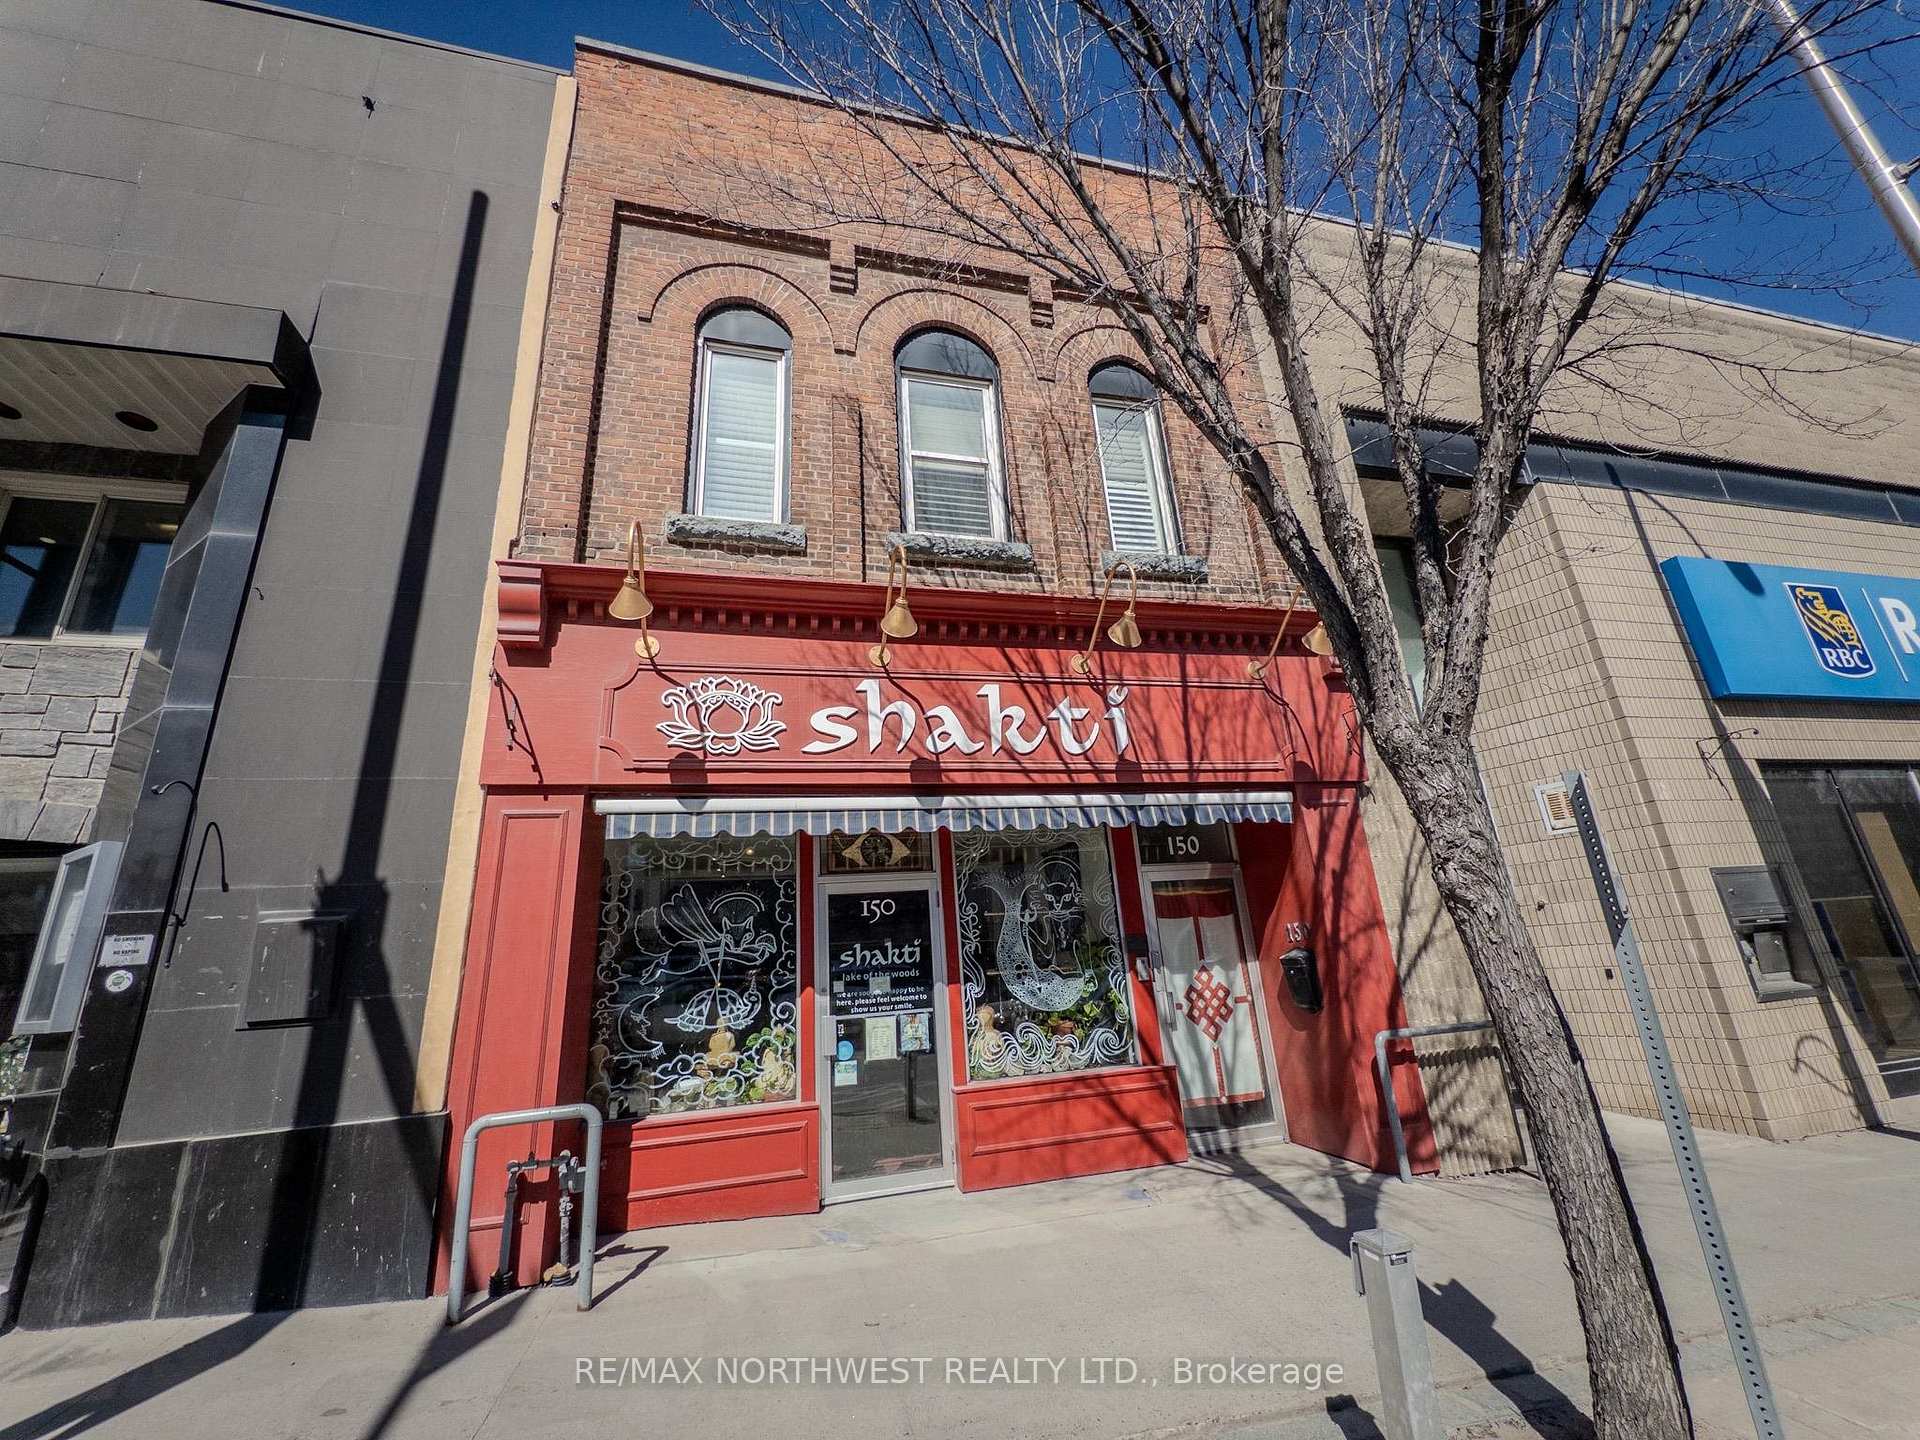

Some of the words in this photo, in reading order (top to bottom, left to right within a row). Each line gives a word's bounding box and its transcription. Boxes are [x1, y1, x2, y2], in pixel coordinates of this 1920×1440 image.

[1821, 647, 1869, 668] RBC
[801, 678, 1129, 756] shakti
[1167, 835, 1199, 855] 150
[860, 899, 896, 924] 150
[840, 938, 921, 968] shakti
[842, 973, 862, 982] lake
[891, 968, 920, 978] woods
[850, 1006, 868, 1014] show
[878, 1004, 893, 1012] your
[894, 1002, 915, 1010] smile.
[855, 997, 876, 1006] please
[876, 995, 890, 1003] feel
[890, 994, 919, 1002] welcome
